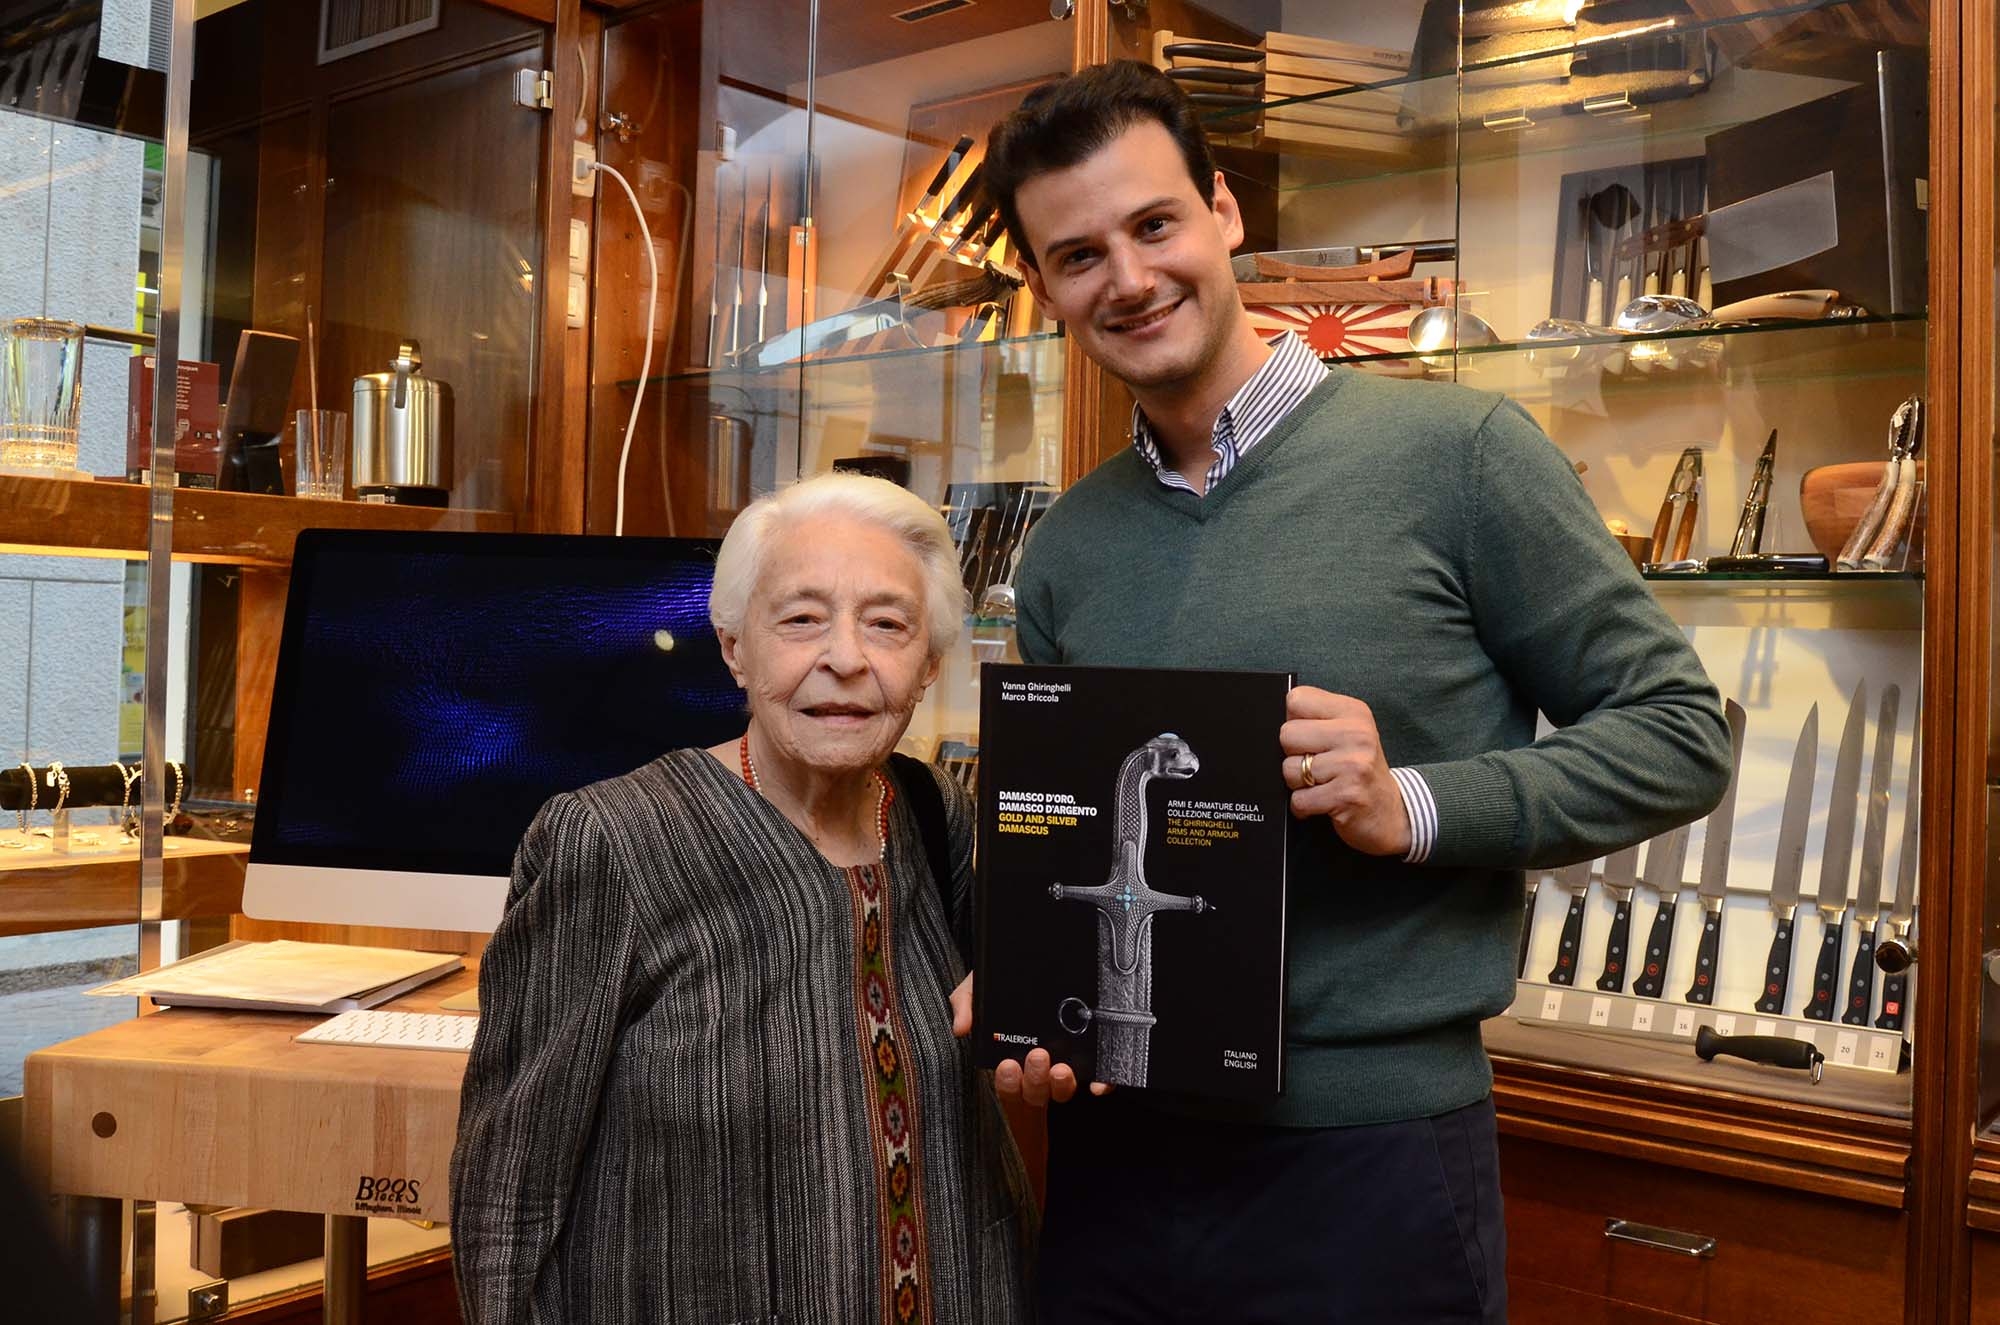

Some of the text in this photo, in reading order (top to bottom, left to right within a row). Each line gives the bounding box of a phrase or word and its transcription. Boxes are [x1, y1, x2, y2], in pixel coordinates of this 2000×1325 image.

[1002, 682, 1071, 693] Vanna Ghiringhelli
[1002, 692, 1058, 702] Marco Briccola
[1000, 791, 1076, 804] DAMASCO D'ORO,
[1000, 802, 1097, 816] DAMASCO D'ARGENTO
[1194, 802, 1233, 810] ARMATURE
[1235, 804, 1258, 812] DELLA
[999, 813, 1077, 826] GOLD AND SILVER
[1168, 809, 1264, 822] COLLEZIONE GHIRINGHELLI
[1168, 818, 1233, 829] THE GHIRINGHELLI
[999, 824, 1048, 835] DAMASCUS
[1168, 828, 1239, 838] ARMS AND ARMOUR
[1166, 837, 1212, 846] COLLECTION
[1224, 1050, 1258, 1060] ITALIANO
[1224, 1059, 1257, 1070] ENGLISH
